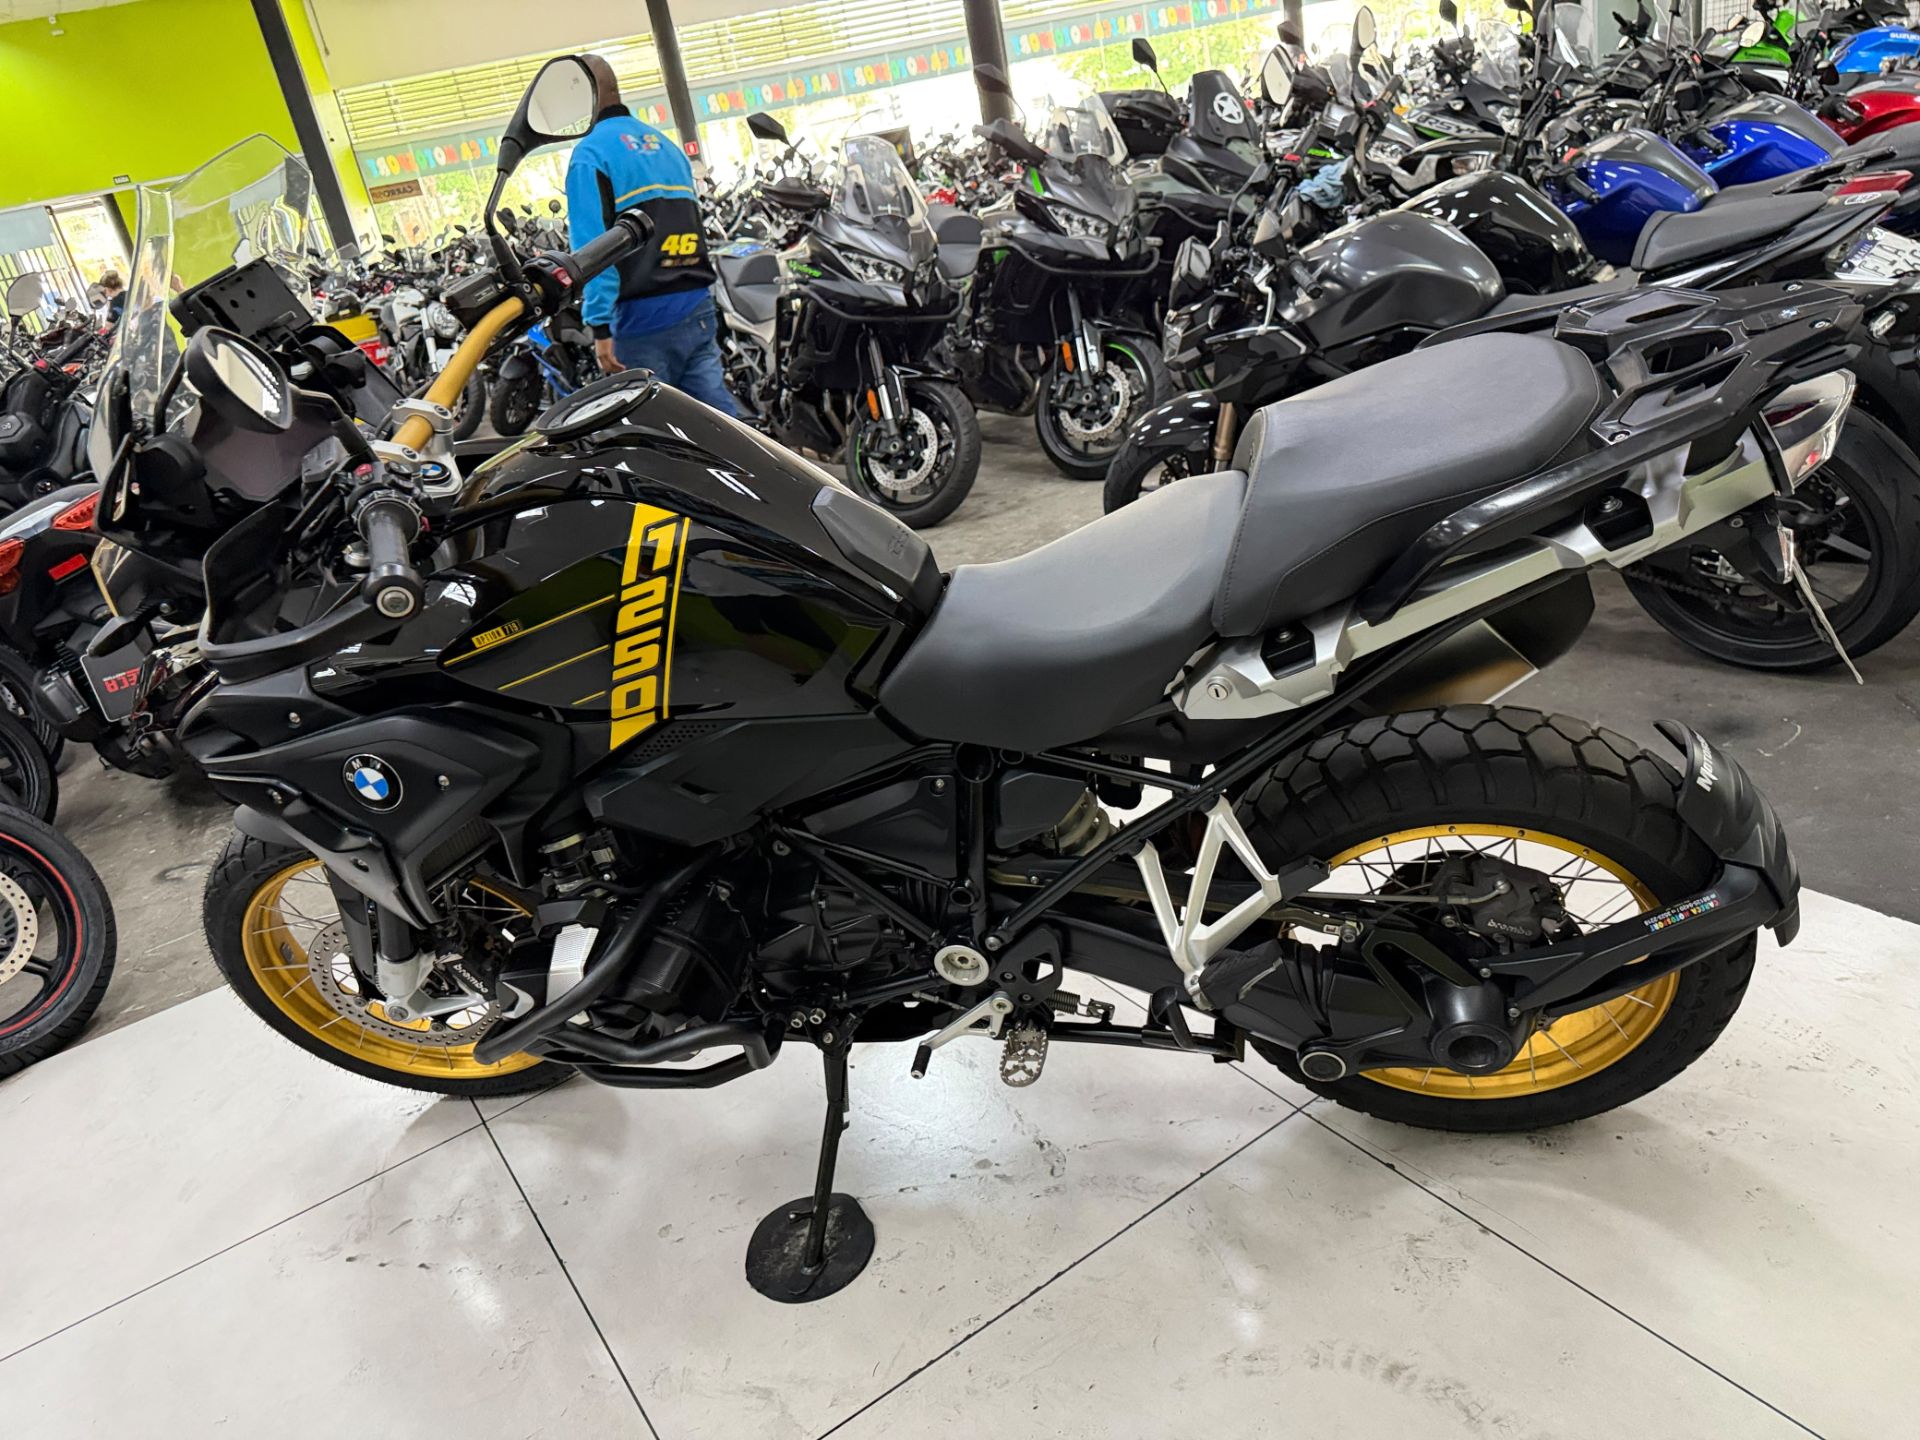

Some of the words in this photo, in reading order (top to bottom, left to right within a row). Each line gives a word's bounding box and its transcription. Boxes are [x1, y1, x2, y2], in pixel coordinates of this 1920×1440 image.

[661, 233, 698, 256] 46
[611, 522, 677, 720] 1250
[345, 757, 382, 783] BMW
[1690, 899, 1720, 915] CARECA
[1486, 918, 1534, 936] brembo
[1649, 910, 1691, 933] MOTOSPORT
[453, 963, 489, 993] brembo
